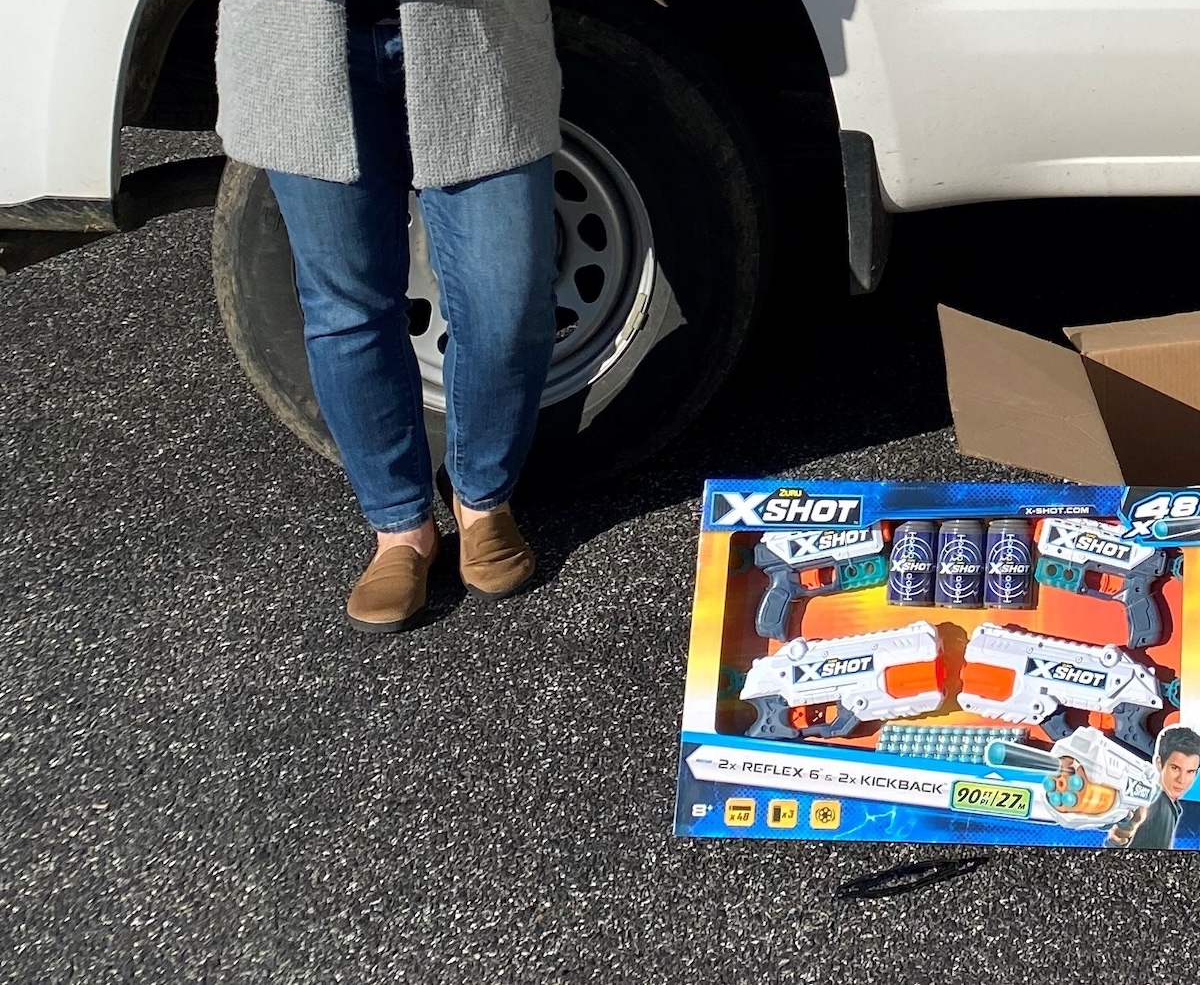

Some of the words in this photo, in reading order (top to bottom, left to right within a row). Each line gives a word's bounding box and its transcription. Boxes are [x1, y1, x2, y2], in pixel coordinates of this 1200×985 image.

[778, 489, 803, 497] ZURU
[1025, 507, 1090, 515] X-SHOT.COM
[1134, 496, 1200, 520] 48
[742, 762, 803, 777] REFLEX
[809, 769, 820, 780] 6
[860, 775, 943, 795] KICKBACK
[957, 787, 981, 805] 90
[995, 792, 1023, 809] 27
